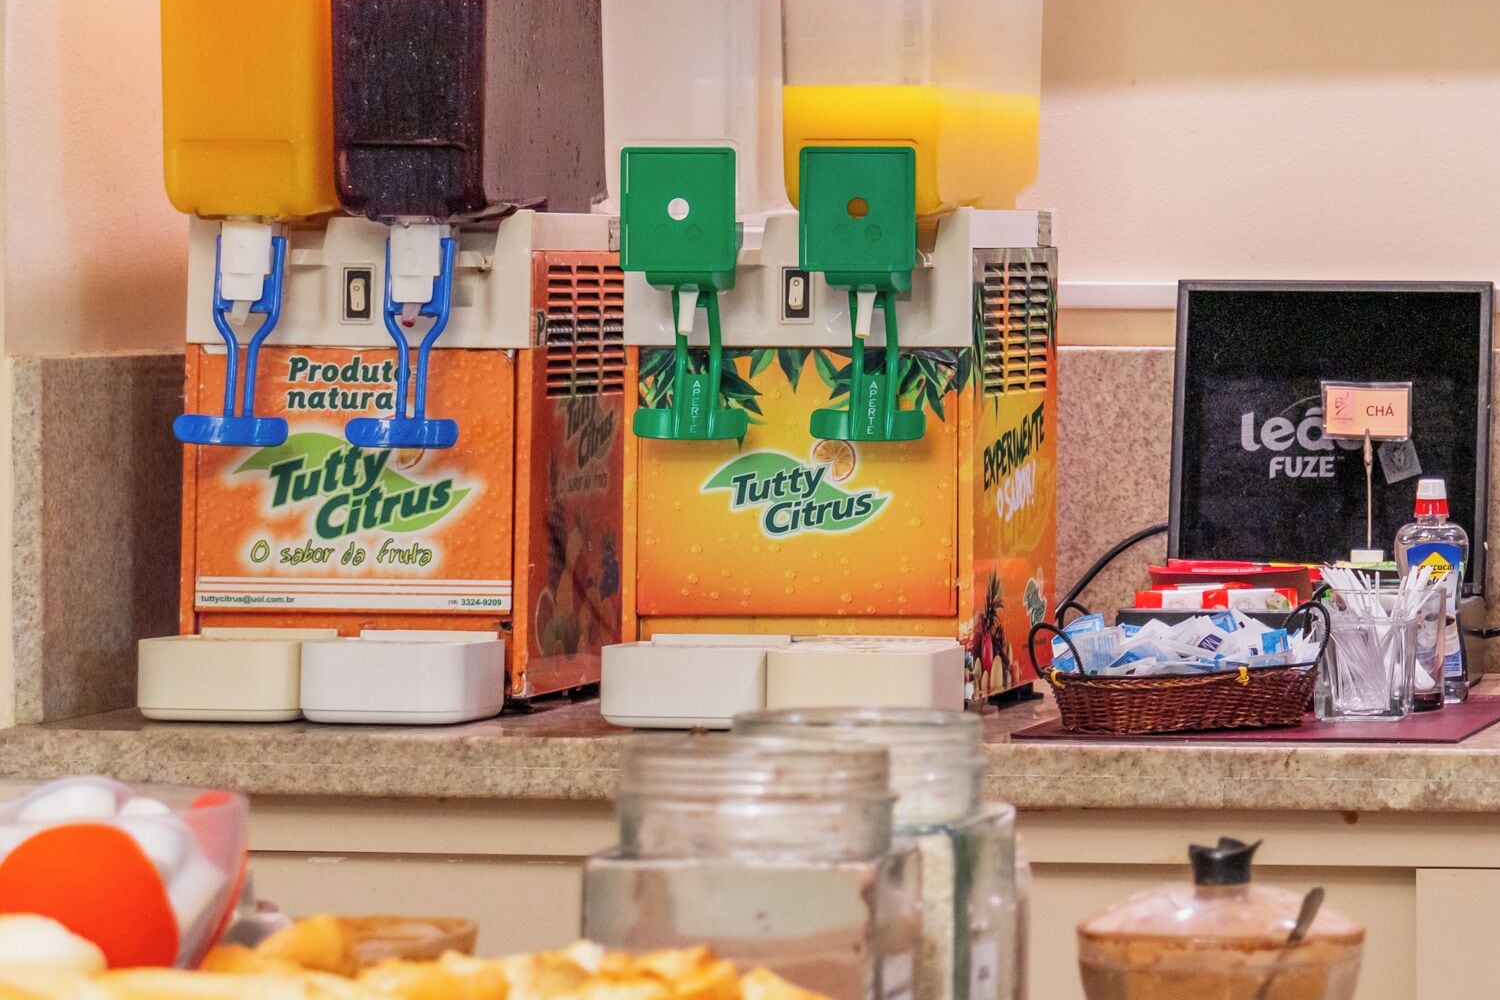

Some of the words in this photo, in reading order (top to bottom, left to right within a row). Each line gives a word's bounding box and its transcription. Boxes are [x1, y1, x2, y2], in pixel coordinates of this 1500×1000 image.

[287, 387, 394, 410] natura
[689, 380, 701, 434] APERTE
[867, 381, 878, 435] APERTE
[1366, 403, 1395, 417] CHÁ
[983, 400, 1045, 492] EXPERIMENTE
[1241, 406, 1364, 451] leã
[268, 447, 392, 508] Tutty
[732, 465, 828, 505] Tutty
[1269, 456, 1335, 479] FUZE
[316, 478, 454, 539] Citrus
[765, 492, 873, 534] Citrus
[251, 539, 270, 563] O
[280, 539, 336, 565] sabor
[341, 541, 366, 566] da
[376, 538, 433, 566] fruta
